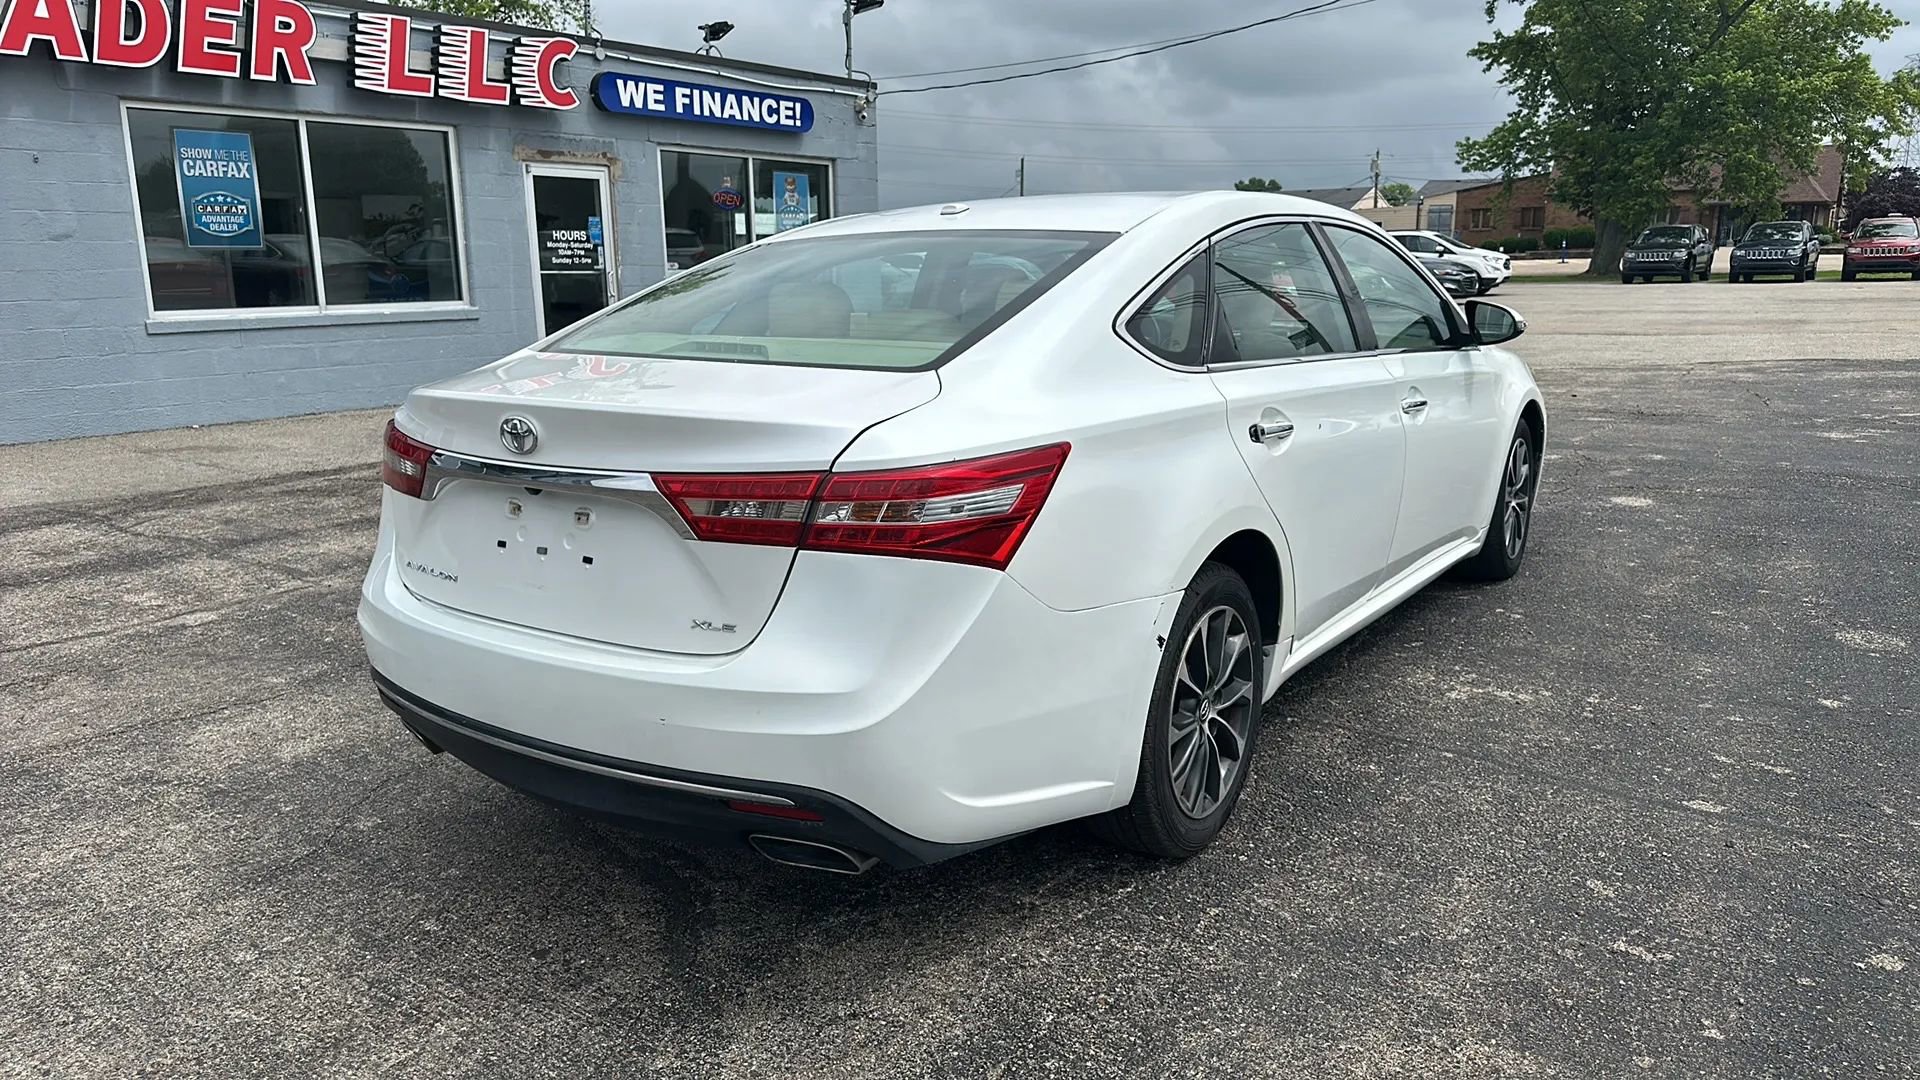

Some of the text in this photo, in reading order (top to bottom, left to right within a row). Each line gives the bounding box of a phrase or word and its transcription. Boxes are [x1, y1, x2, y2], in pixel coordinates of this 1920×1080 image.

[354, 12, 580, 110] LLC
[616, 79, 802, 127] WE FINANCE!
[180, 147, 249, 162] SHOW ME THE
[182, 159, 251, 179] CARFAX
[713, 192, 741, 206] OPEN
[196, 205, 247, 215] CARFAX
[201, 215, 245, 224] ADVANTAGE
[209, 223, 239, 232] DEALER
[552, 230, 587, 241] HOURS
[546, 241, 594, 250] Monday-Saturday
[551, 257, 573, 265] Sunday
[406, 560, 459, 582] AVALON
[690, 619, 737, 633] XLE
